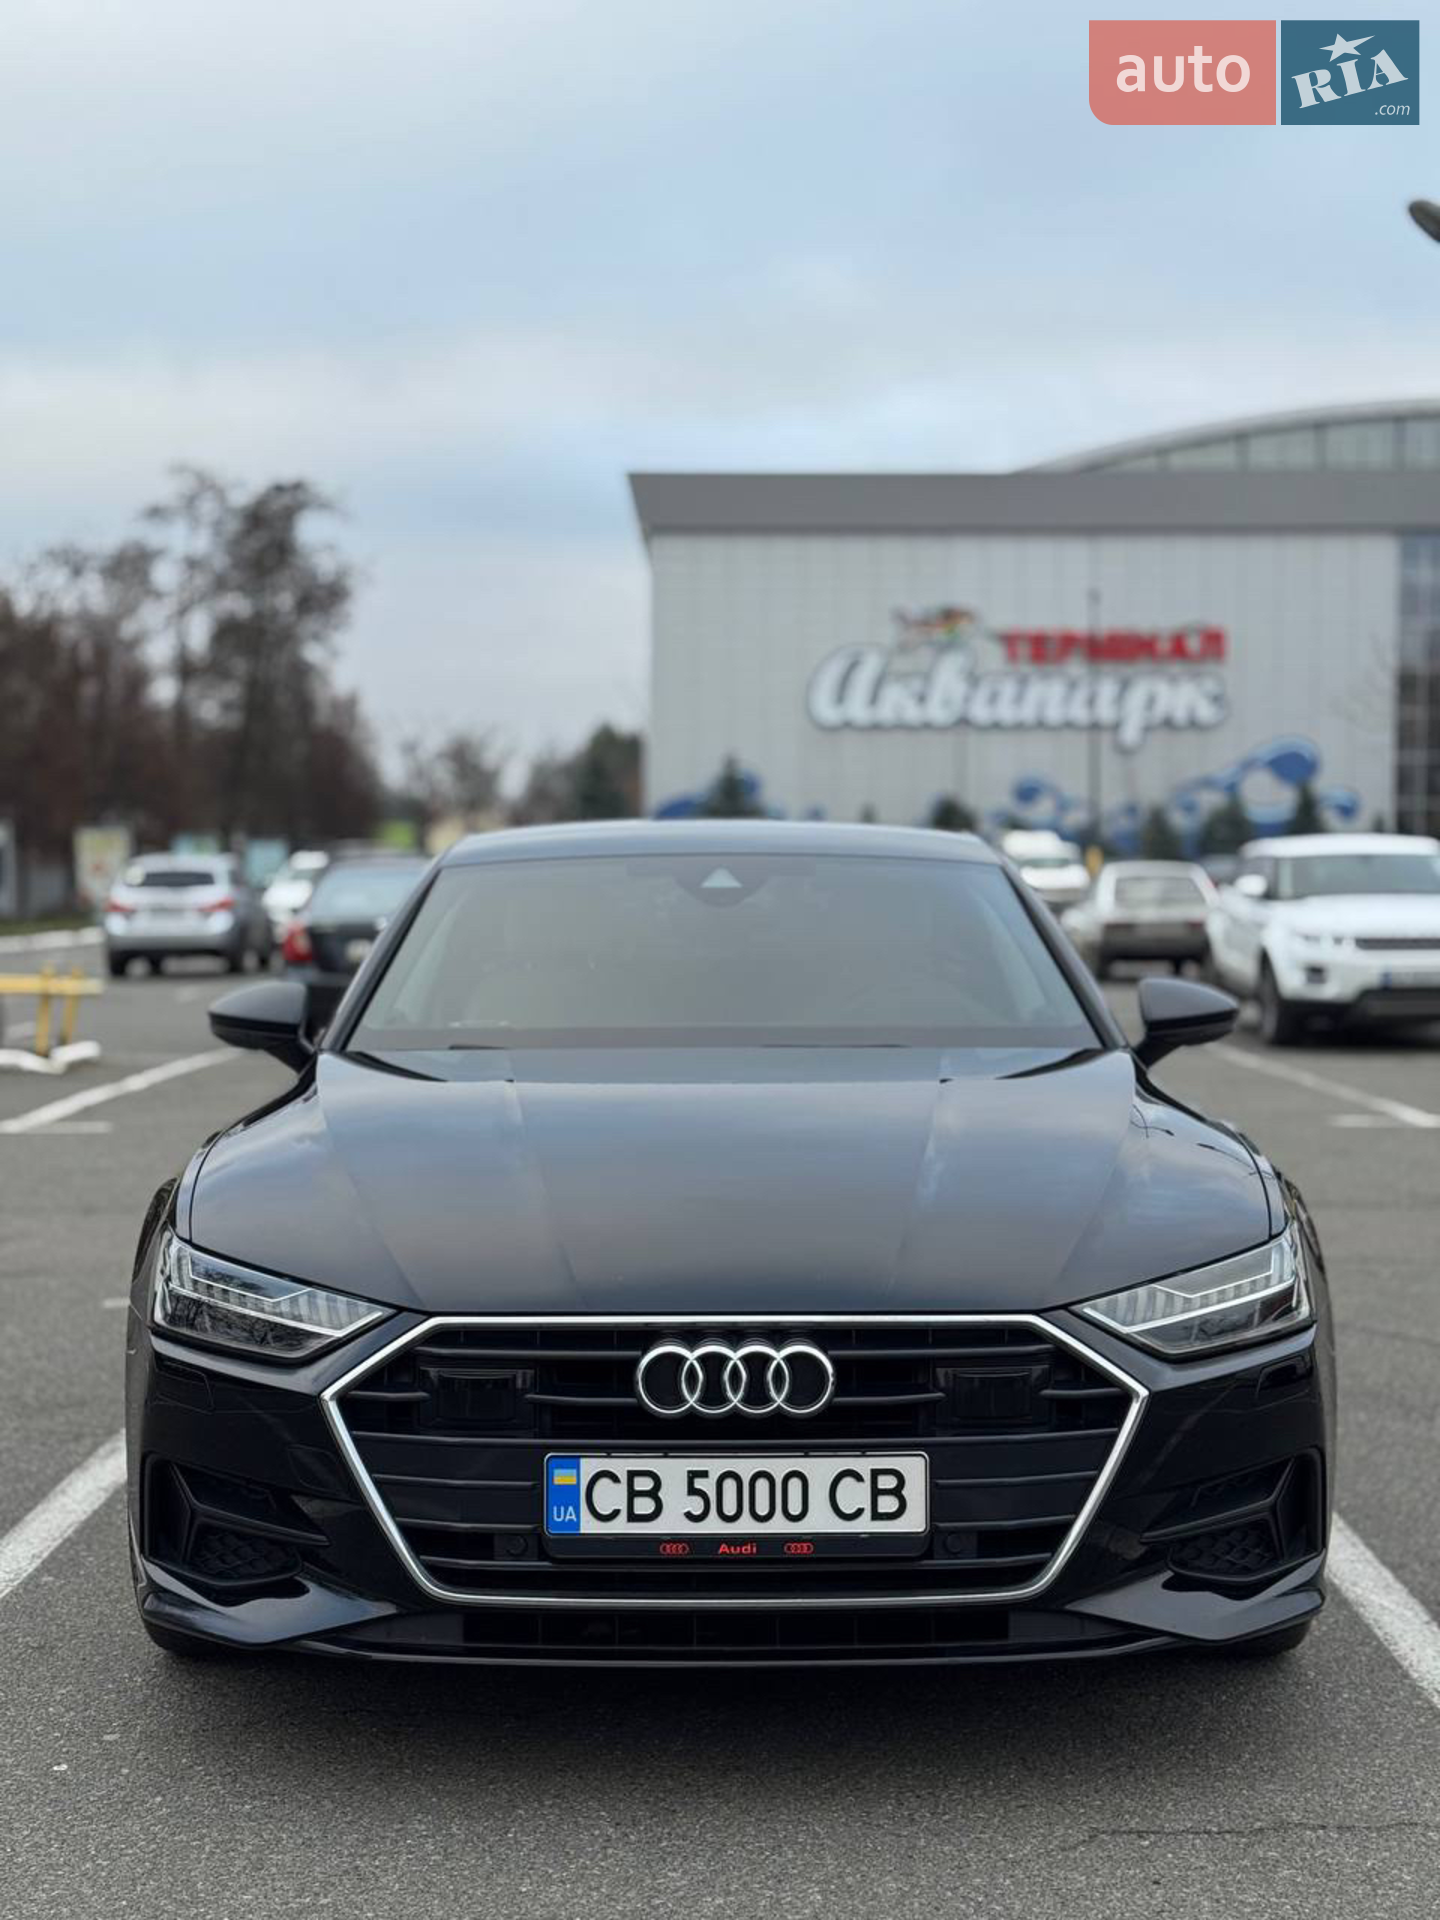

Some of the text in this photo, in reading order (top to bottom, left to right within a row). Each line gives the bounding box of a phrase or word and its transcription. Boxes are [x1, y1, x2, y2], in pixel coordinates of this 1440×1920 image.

[585, 1468, 908, 1523] CB 5000 CB
[553, 1505, 577, 1522] UA
[718, 1543, 757, 1555] Audi
